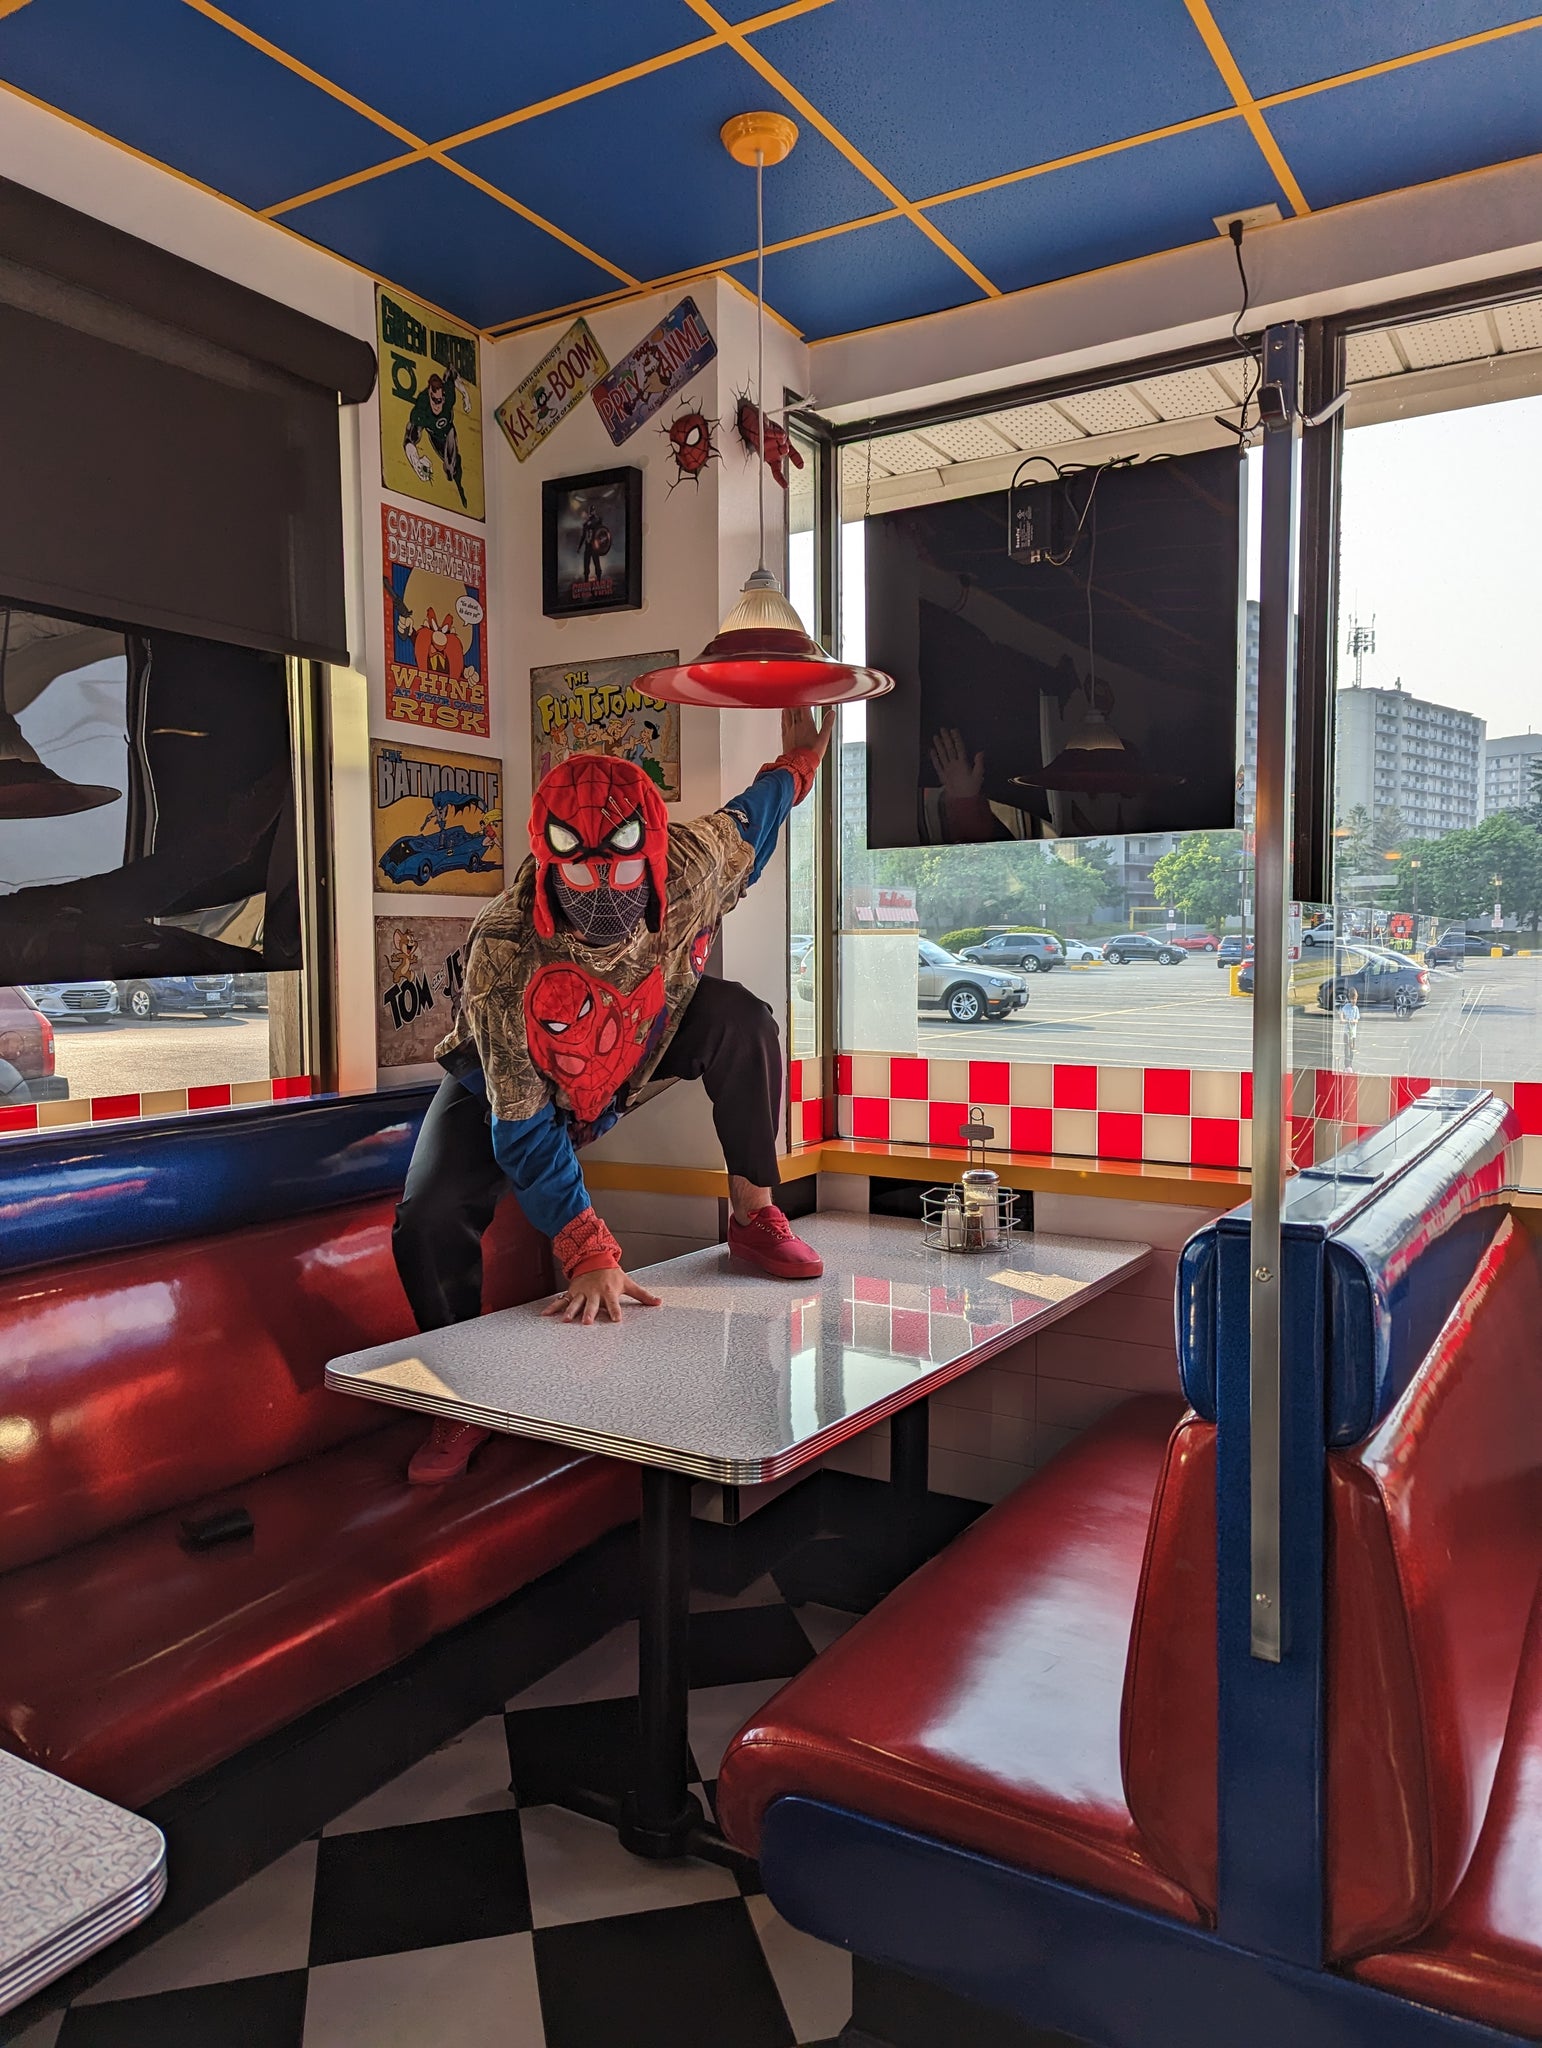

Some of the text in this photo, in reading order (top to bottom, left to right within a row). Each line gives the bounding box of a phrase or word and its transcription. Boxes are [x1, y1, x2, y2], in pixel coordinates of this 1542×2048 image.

[381, 294, 427, 357] GREEN
[504, 333, 599, 447] KA BOOM
[518, 375, 534, 394] EARTH
[598, 314, 709, 433] PRTY ANML
[387, 510, 480, 562] COMPLAINT
[387, 535, 481, 587] DEPARTMENT
[391, 665, 485, 704] WHINE
[394, 686, 411, 697] AT
[415, 691, 451, 708] YOUR
[564, 671, 588, 688] THE
[392, 696, 486, 733] RISK
[377, 756, 499, 809] BATMOBILE
[384, 970, 434, 1031] TOM
